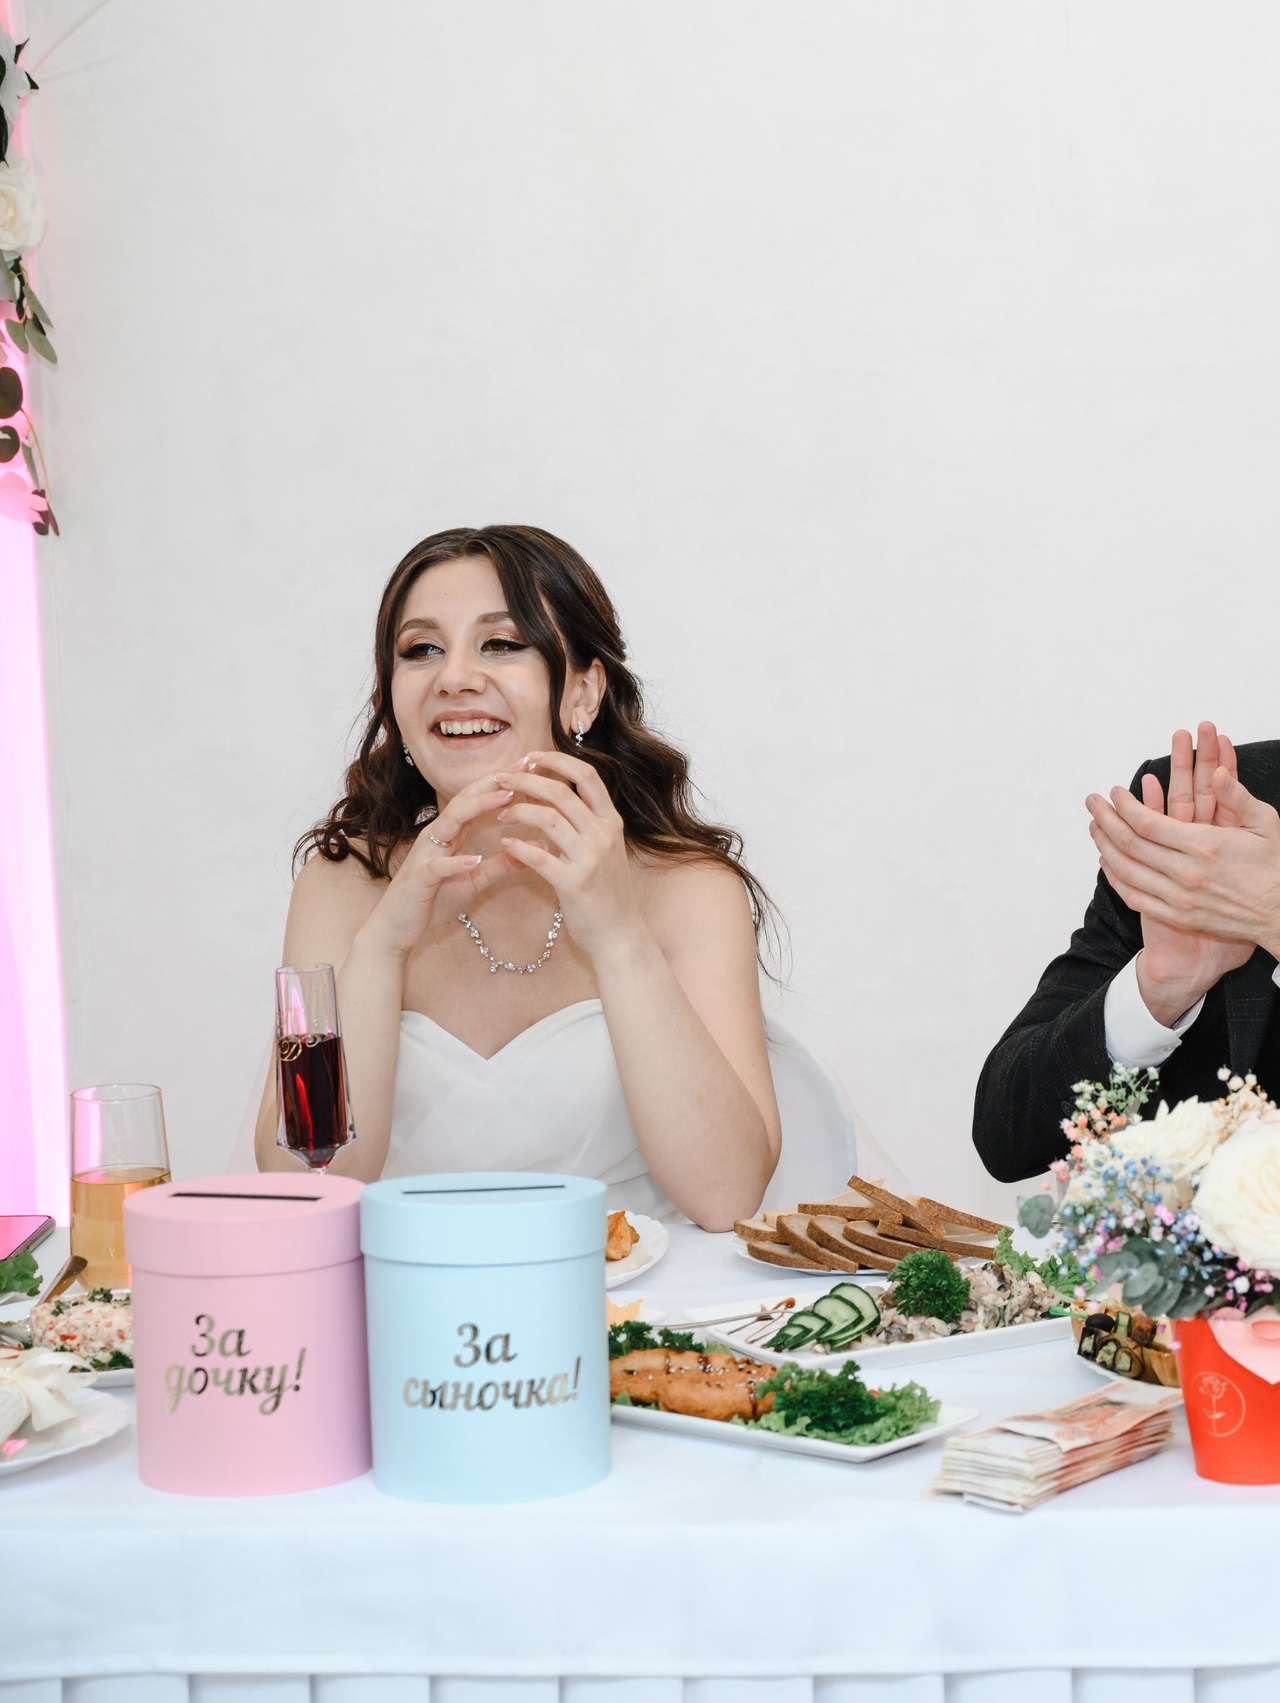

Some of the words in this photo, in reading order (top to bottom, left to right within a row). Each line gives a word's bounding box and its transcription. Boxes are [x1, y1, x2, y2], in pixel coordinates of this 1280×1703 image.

[191, 1314, 251, 1358] За
[453, 1322, 518, 1369] За
[163, 1346, 308, 1416] дочку!
[403, 1356, 582, 1412] сыночка!
